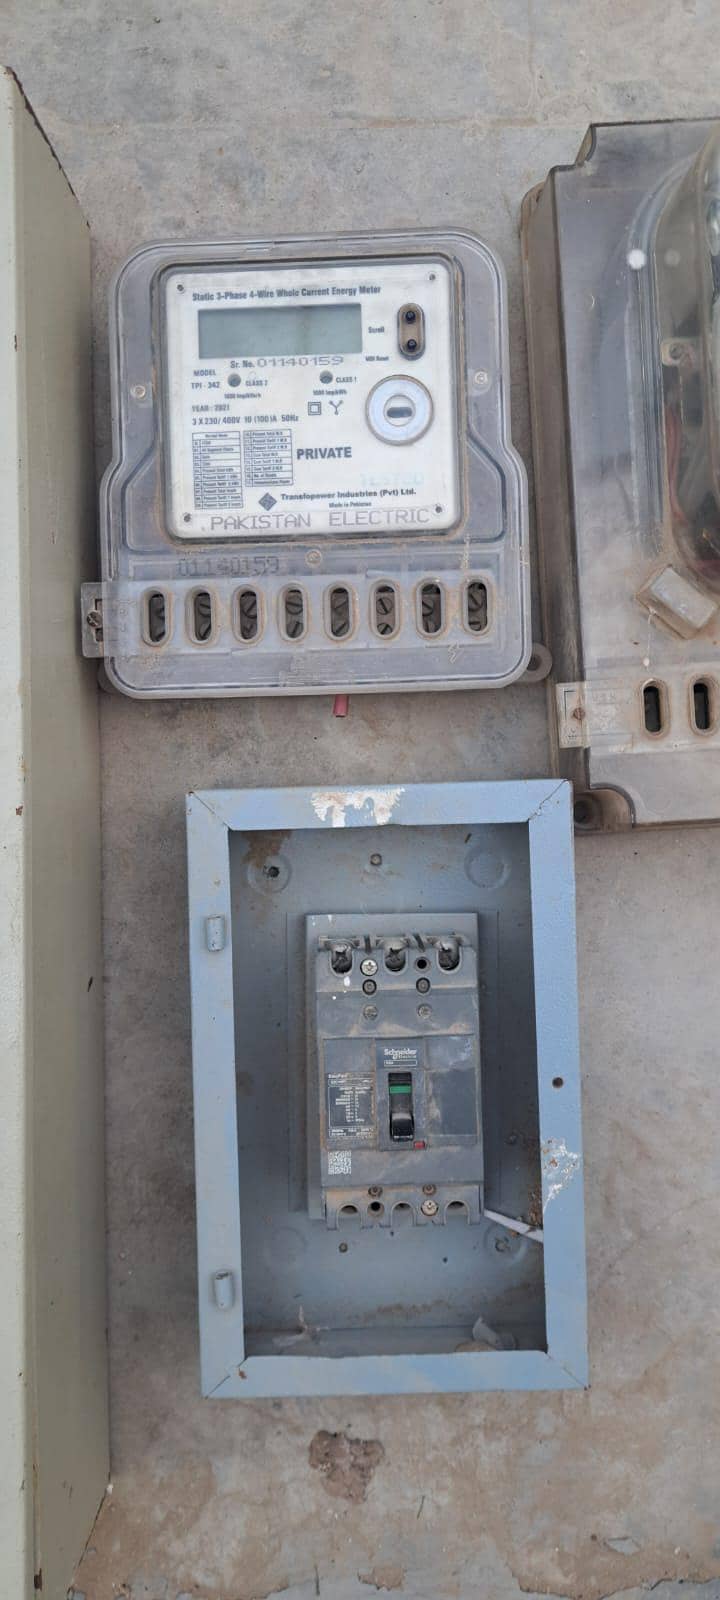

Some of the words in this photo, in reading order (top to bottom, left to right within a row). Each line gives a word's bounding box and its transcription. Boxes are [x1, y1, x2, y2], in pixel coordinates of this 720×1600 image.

[193, 292, 214, 301] Static
[217, 291, 247, 300] 3-Phase
[249, 289, 274, 298] 4-Wire
[276, 288, 299, 297] Whole
[301, 287, 329, 296] Current
[332, 286, 357, 297] Energy
[359, 285, 381, 294] Meter
[230, 360, 240, 369] Sr.
[242, 360, 255, 368] No.
[257, 355, 344, 368] 01140159
[193, 369, 216, 377] MODEL
[208, 381, 220, 389] 342
[281, 414, 299, 422] 50Hz
[297, 447, 353, 460] PRIVATE
[281, 491, 336, 501] Transfopower
[337, 489, 378, 499] Industries
[379, 488, 399, 498] (Pvt)
[400, 487, 417, 496] Ltd.
[211, 511, 311, 530] PAKISTAN
[329, 508, 430, 527] ELECTRIC
[383, 1048, 417, 1057] Schneider
